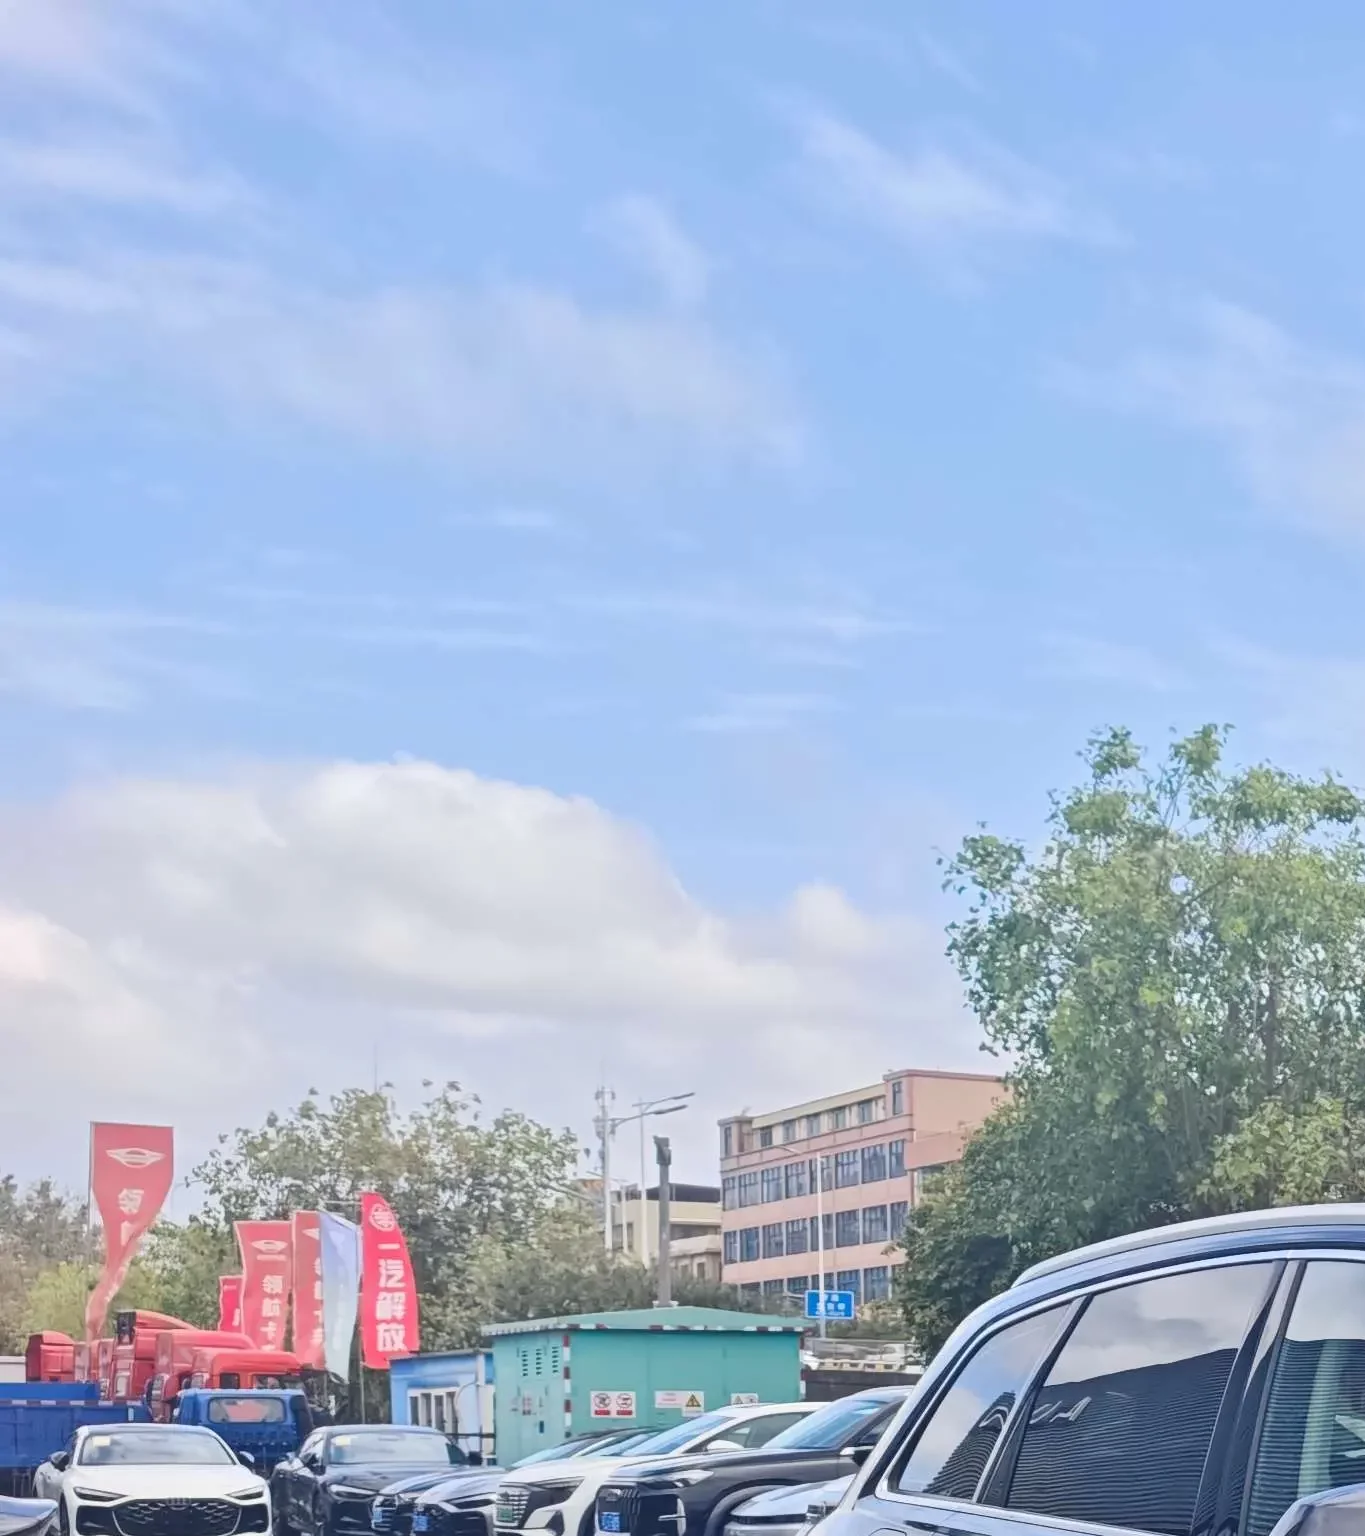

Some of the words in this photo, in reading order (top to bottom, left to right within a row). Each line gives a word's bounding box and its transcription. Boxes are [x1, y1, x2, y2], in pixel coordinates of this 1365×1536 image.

[260, 1275, 283, 1350] 领航卡
[375, 1243, 407, 1352] 一汽解放
